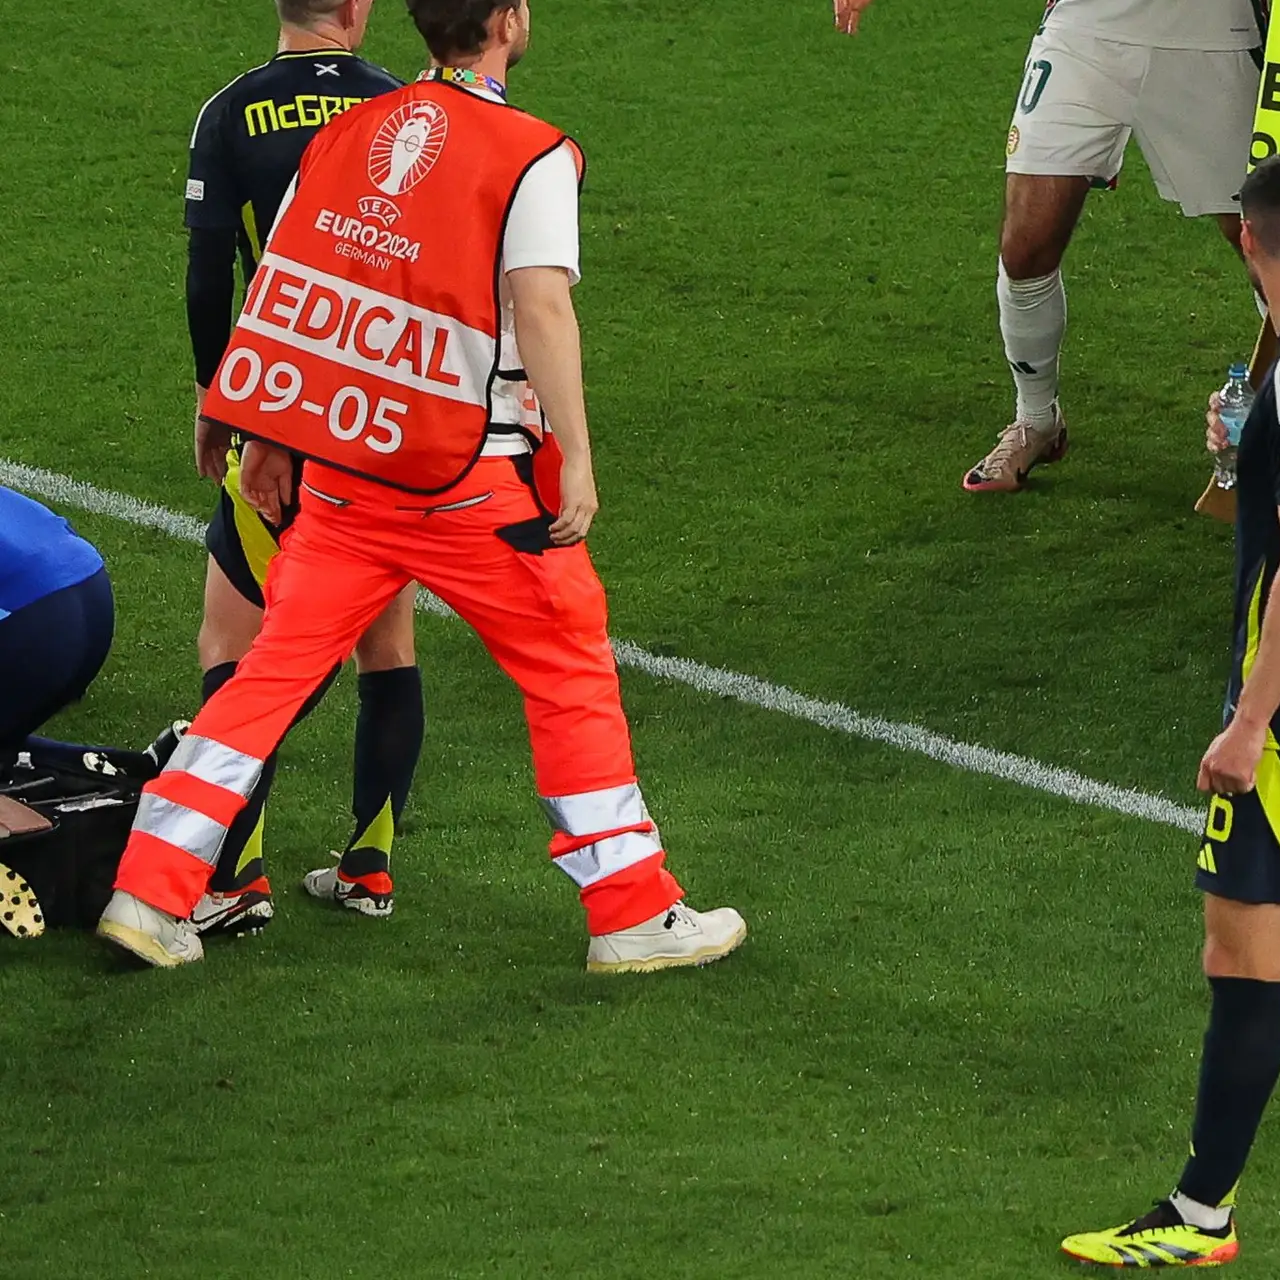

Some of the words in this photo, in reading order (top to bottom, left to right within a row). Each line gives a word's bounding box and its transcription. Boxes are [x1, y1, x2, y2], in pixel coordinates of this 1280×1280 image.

[244, 94, 374, 137] McGR
[358, 200, 398, 226] UEFA
[314, 208, 421, 263] EURO2024
[334, 241, 393, 271] GERMANY
[219, 346, 409, 455] 09-05
